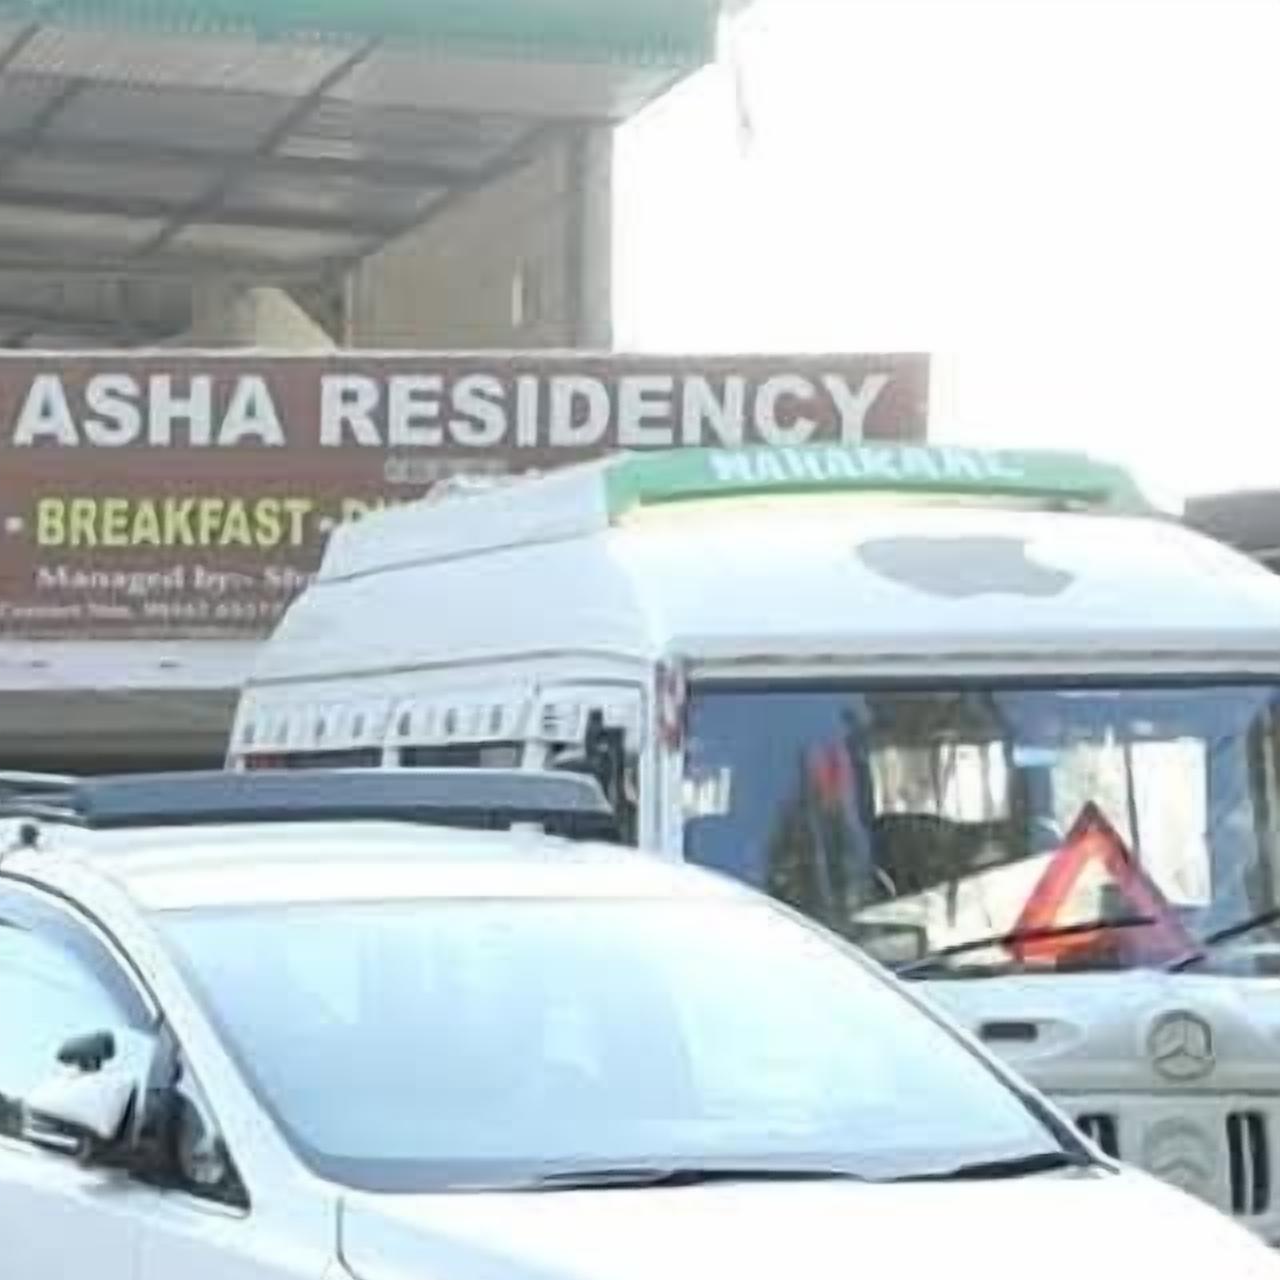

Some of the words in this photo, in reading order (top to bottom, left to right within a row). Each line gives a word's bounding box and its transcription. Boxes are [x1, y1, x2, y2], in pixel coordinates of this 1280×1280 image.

[11, 374, 286, 448] ASHA
[317, 374, 895, 448] RESIDENCY
[35, 497, 313, 547] BREAKFAST
